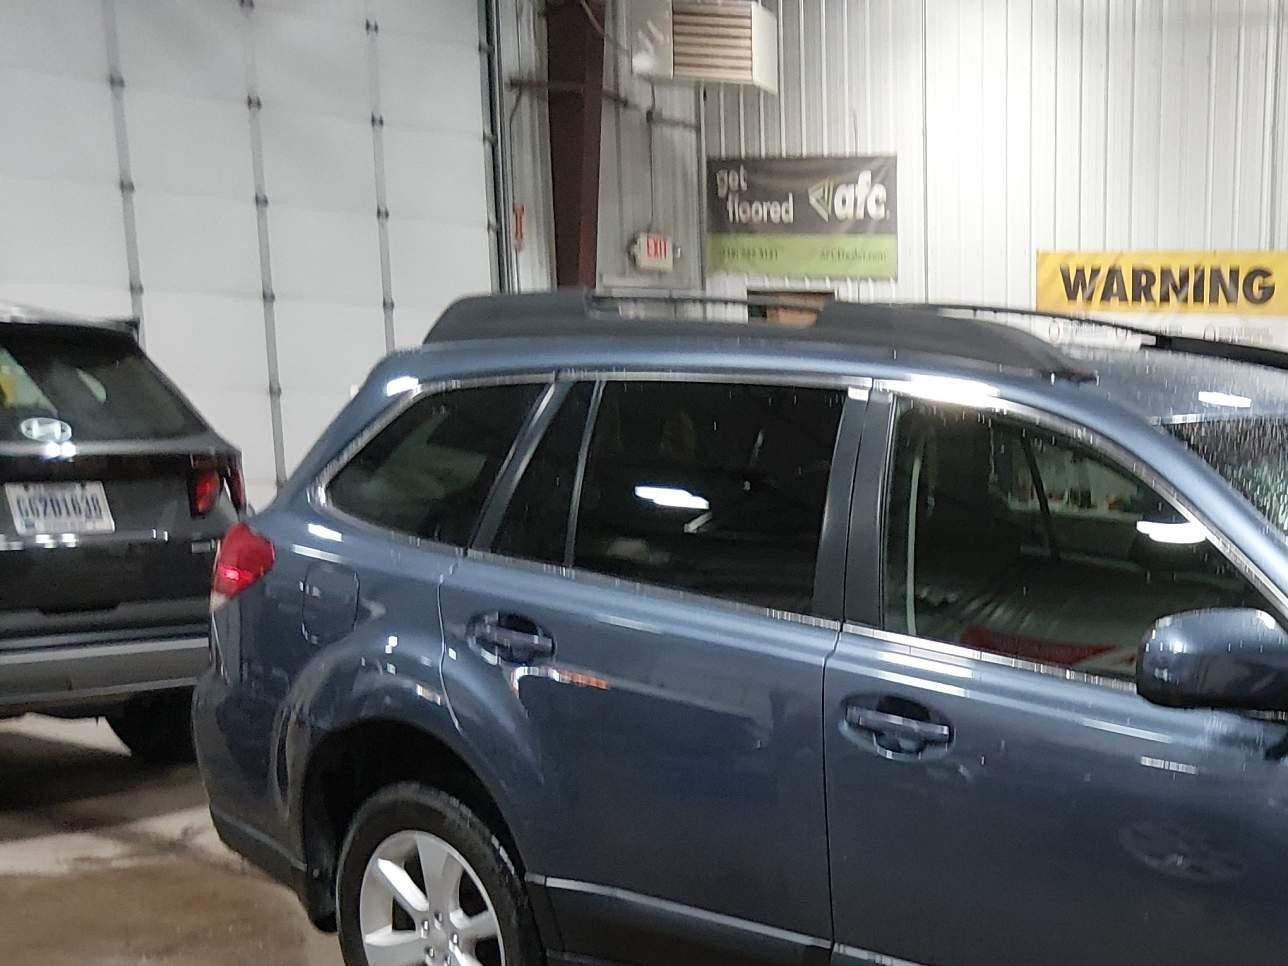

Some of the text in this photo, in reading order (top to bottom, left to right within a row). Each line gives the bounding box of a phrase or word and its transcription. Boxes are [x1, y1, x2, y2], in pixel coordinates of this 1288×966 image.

[716, 163, 748, 198] get
[726, 192, 794, 224] floored
[646, 238, 667, 258] EXIT
[1060, 263, 1276, 306] WARNING
